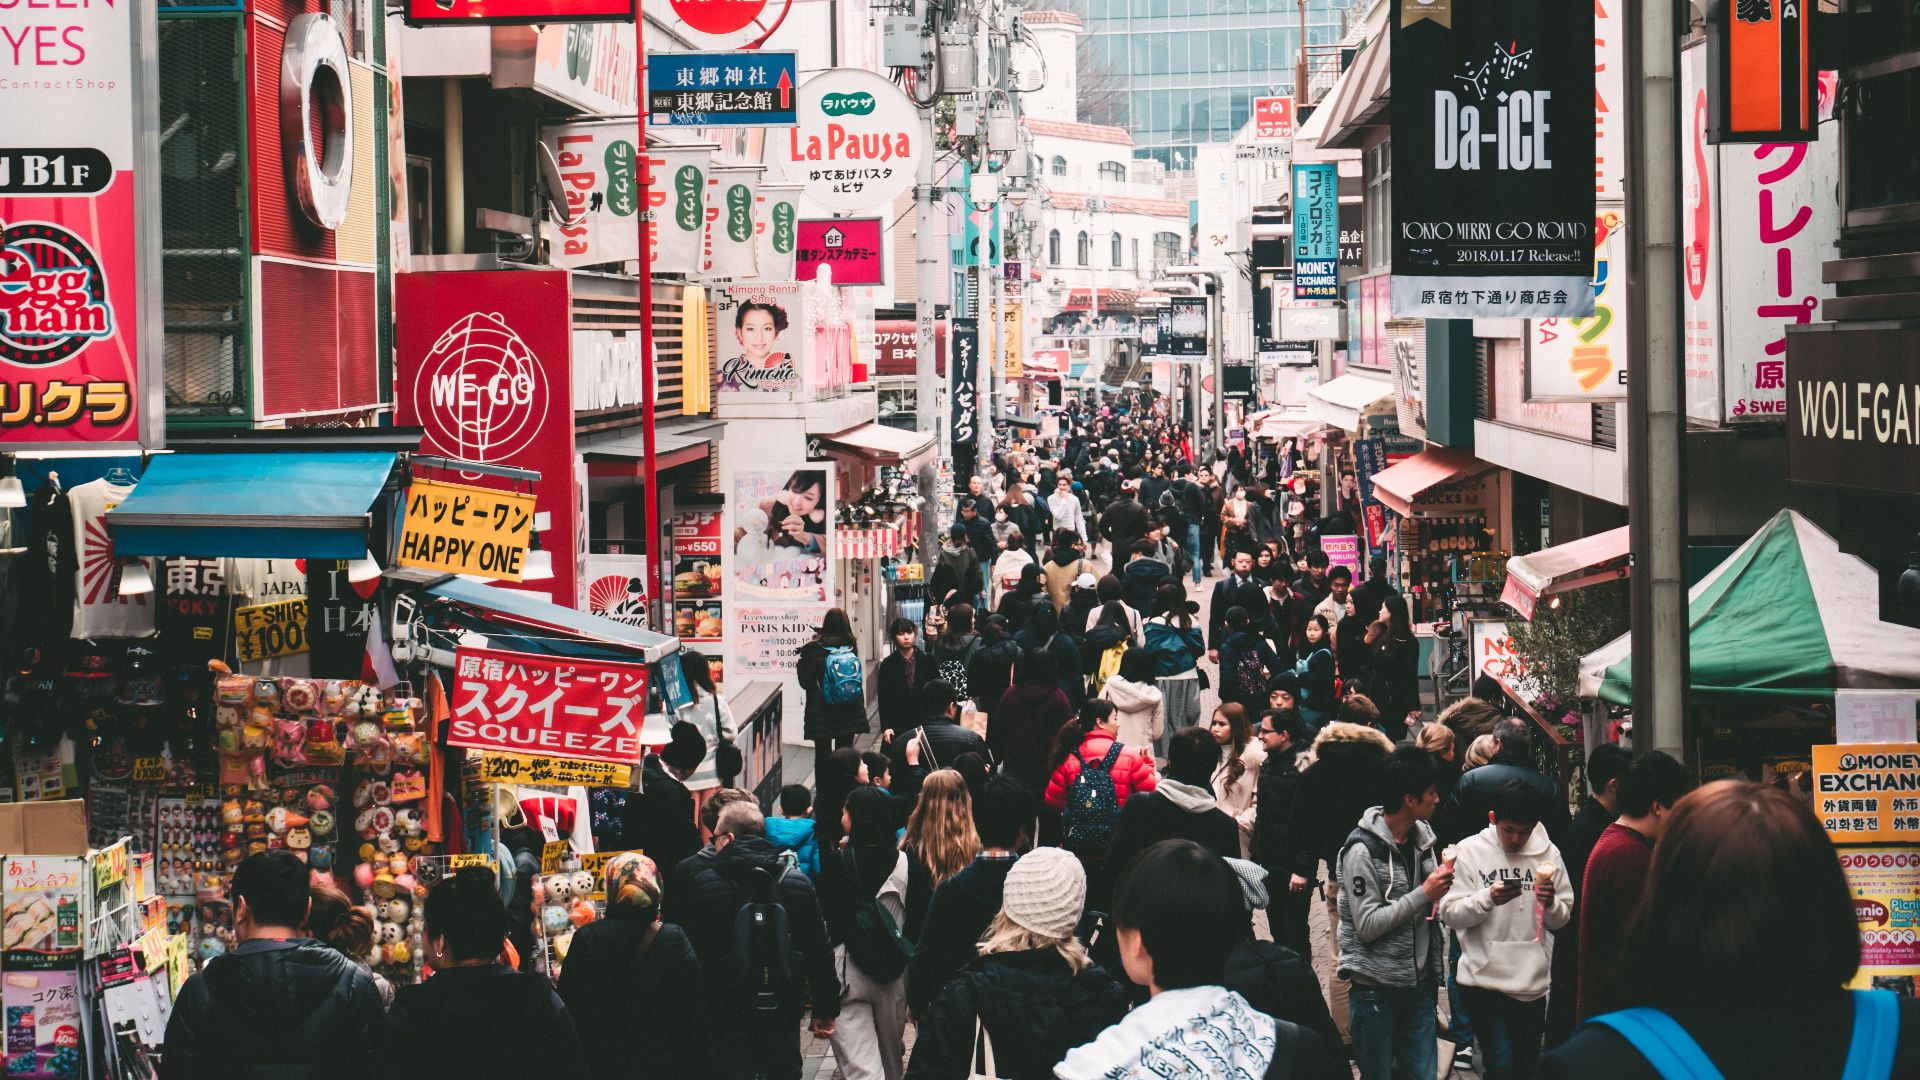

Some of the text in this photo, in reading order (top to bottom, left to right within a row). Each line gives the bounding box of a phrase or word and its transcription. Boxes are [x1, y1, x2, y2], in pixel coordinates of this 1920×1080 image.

[676, 66, 768, 86] 東郷神社
[676, 92, 773, 111] 東郷記念館
[823, 98, 874, 110] ラパウザ
[1434, 90, 1552, 171] Da-iCE
[558, 135, 594, 167] La
[791, 123, 911, 163] La Pausa
[613, 143, 632, 214] ラパウザ
[810, 168, 892, 181] ゆであげパスタ
[833, 182, 864, 193] &ピザ
[682, 168, 697, 230] ラパウザ
[1310, 170, 1323, 256] コインロッカー
[1324, 170, 1333, 256] Rental Coin Locker
[827, 235, 840, 244] 6F
[1402, 222, 1587, 240] TOKYO MERRY GO ROUND
[1457, 249, 1581, 263] 2018.01.17 Release!!
[1297, 262, 1336, 275] MONEY
[728, 285, 800, 295] Kimono Rental
[1297, 276, 1337, 286] EXCHANGE
[718, 302, 733, 311] 3F
[751, 294, 777, 306] Shop
[1421, 289, 1568, 305] 原宿竹下通り商店会
[991, 311, 1016, 322] CFE
[723, 357, 797, 389] Kimono
[955, 381, 976, 442] ハセガワ
[409, 494, 529, 534] ハッピーワン
[402, 531, 523, 575] HAPPY ONE
[261, 581, 307, 596] JAPA
[744, 612, 798, 621] Accessory shop
[741, 623, 815, 633] PARIS KID'S
[242, 620, 310, 660] ¥100
[458, 655, 645, 695] 原宿ハッピーワン
[455, 681, 642, 736] スクイーズ
[452, 720, 641, 754] SQUEEZE
[1820, 773, 1920, 792] EXCHAN
[1824, 799, 1878, 812] 外貨両替
[1825, 817, 1878, 831] 외화환전
[1352, 875, 1366, 896] 3
